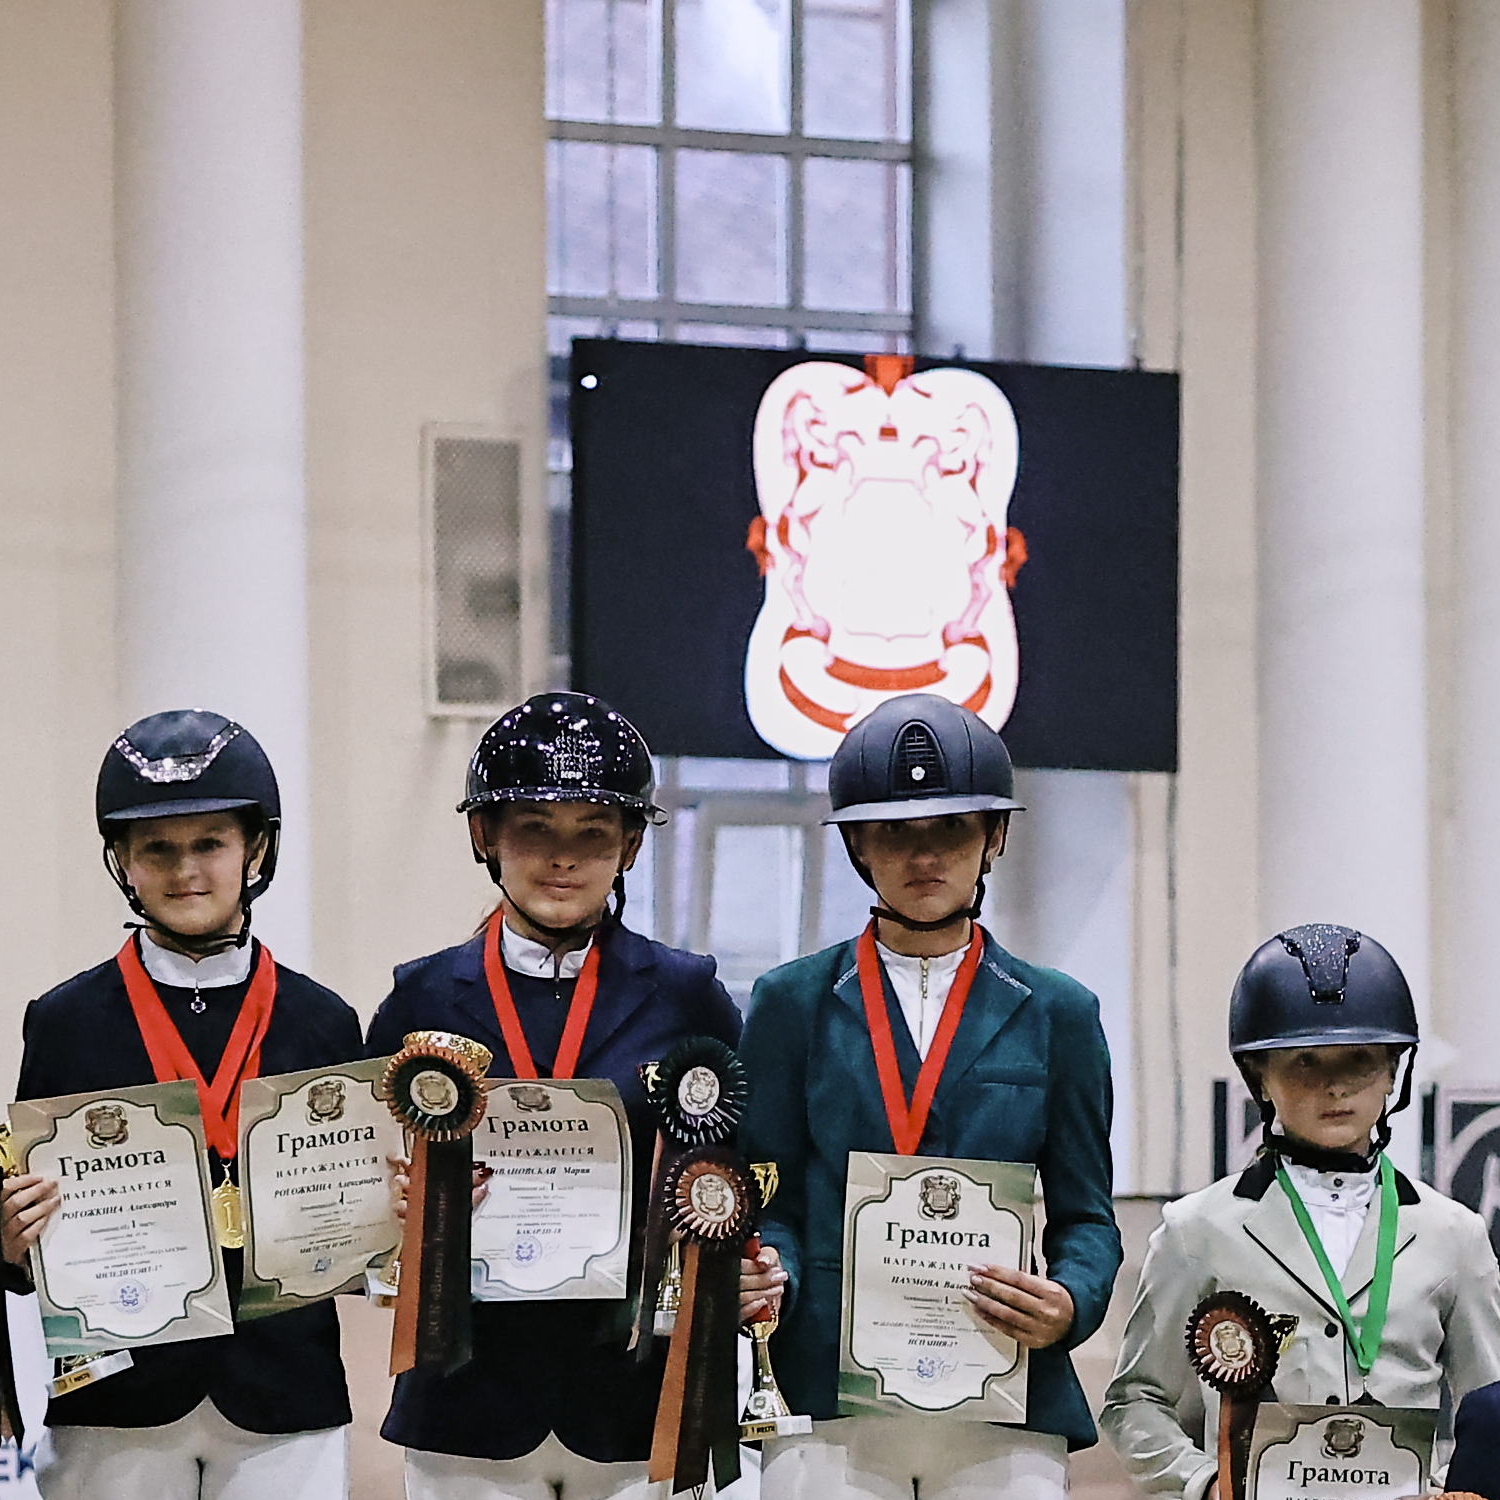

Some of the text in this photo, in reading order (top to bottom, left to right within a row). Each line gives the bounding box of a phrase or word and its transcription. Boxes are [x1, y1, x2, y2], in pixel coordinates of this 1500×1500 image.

[486, 1116, 589, 1139] Грамота
[277, 1126, 376, 1158] Грамота
[489, 1146, 594, 1157] НАГРАЖДАЕТСЯ
[58, 1149, 167, 1182] Грамота
[275, 1156, 378, 1179] НАГРАЖДАЕТСЯ
[563, 1166, 591, 1176] Мария
[62, 1179, 173, 1202] НАГРАЖДАЕТСЯ
[274, 1182, 332, 1199] РОГОЖКИНА
[61, 1205, 124, 1221] РОГОЖКИНА
[885, 1221, 991, 1249] Грамота
[891, 1275, 939, 1288] НАУМОВА
[1286, 1461, 1391, 1487] Грамота
